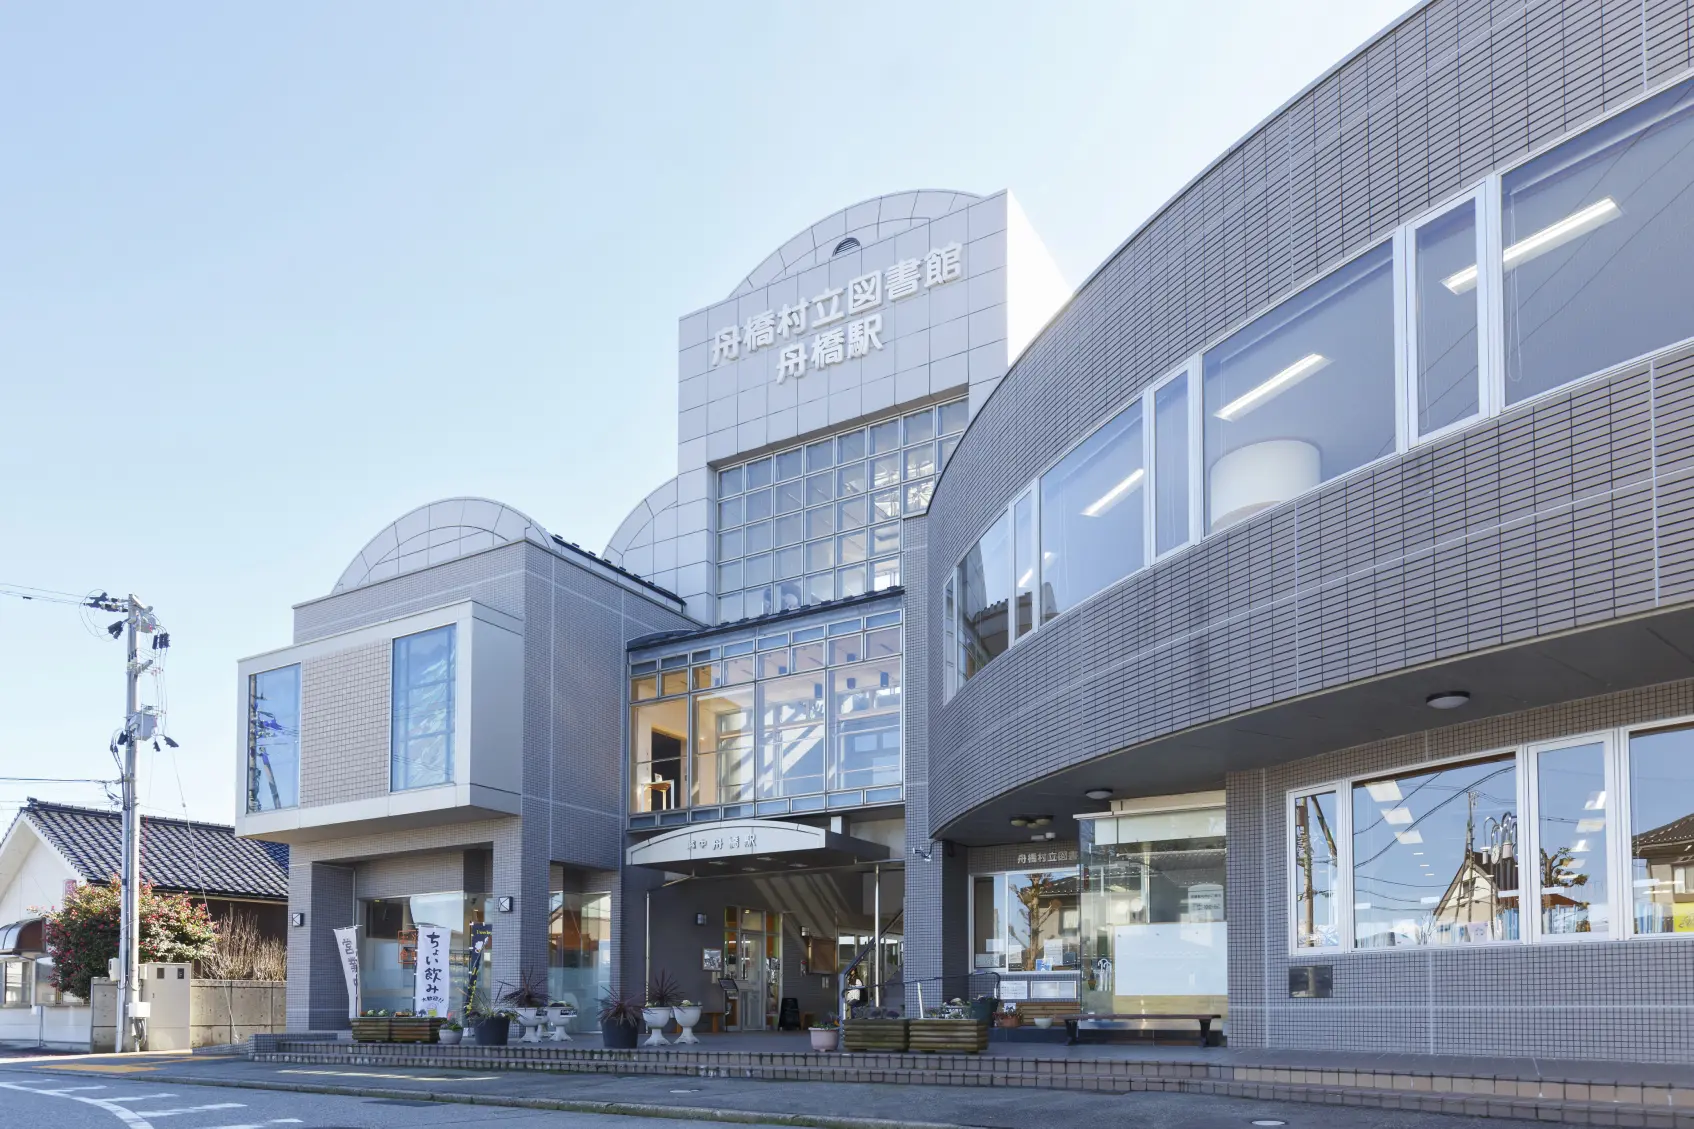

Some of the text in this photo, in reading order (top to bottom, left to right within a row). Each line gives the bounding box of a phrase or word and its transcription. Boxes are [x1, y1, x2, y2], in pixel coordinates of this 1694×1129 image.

[711, 241, 964, 366] 舟橋村立図書館
[776, 313, 884, 384] 舟橋駅
[424, 931, 443, 994] ちょい飲み
